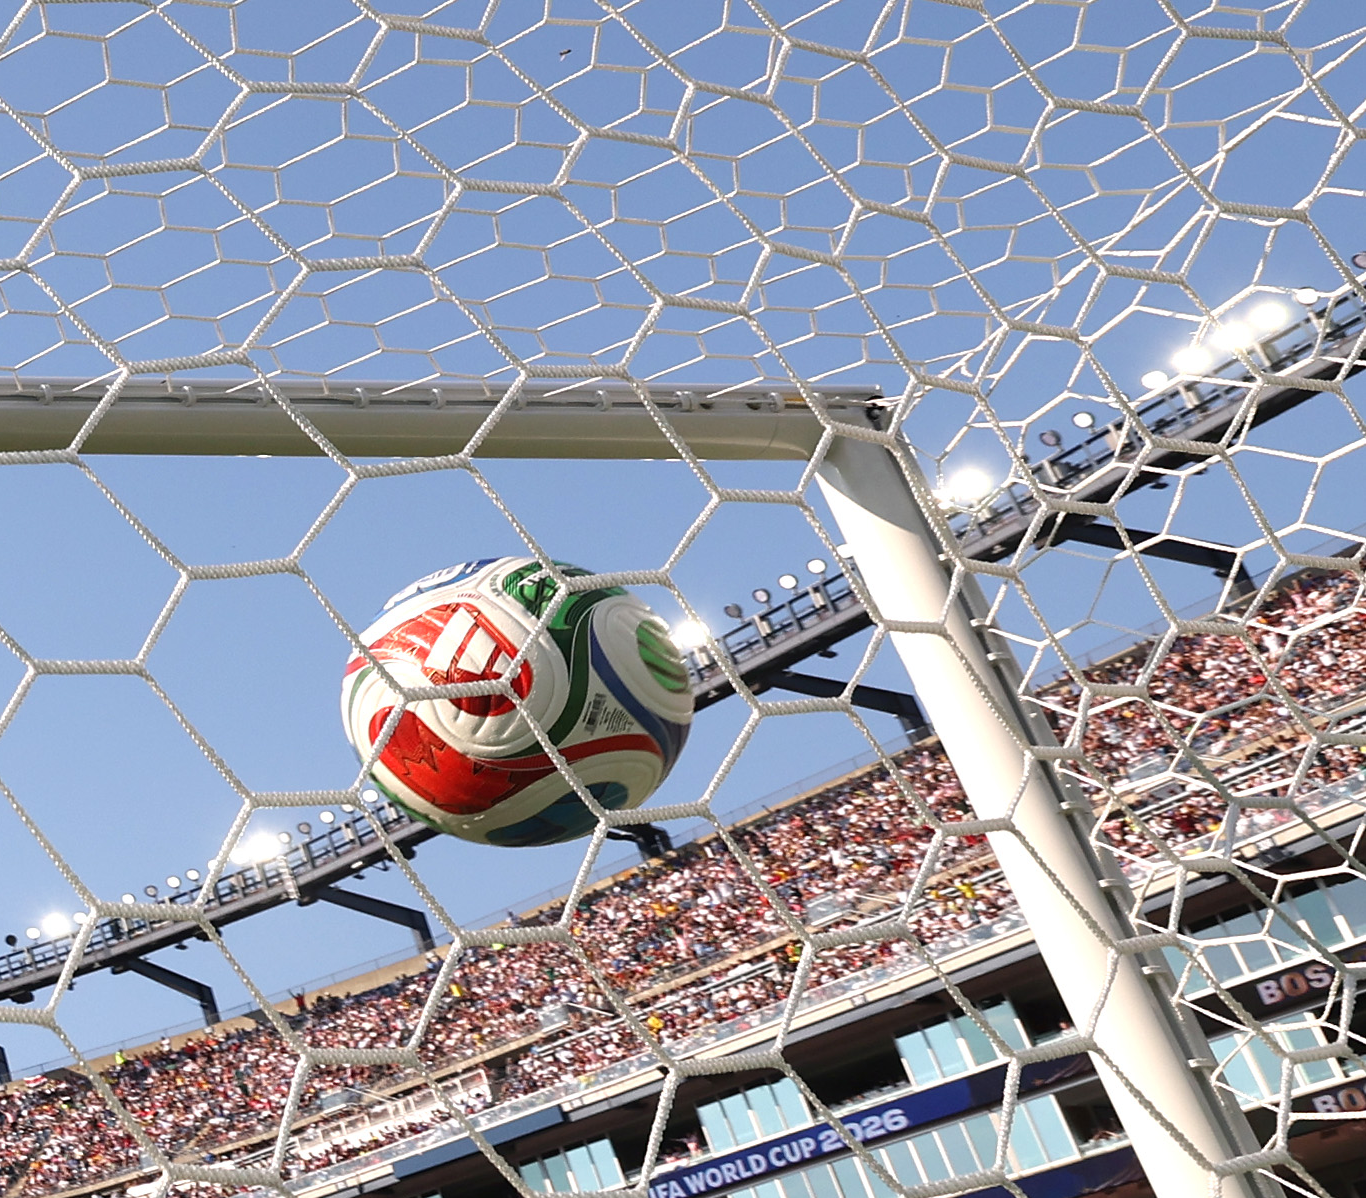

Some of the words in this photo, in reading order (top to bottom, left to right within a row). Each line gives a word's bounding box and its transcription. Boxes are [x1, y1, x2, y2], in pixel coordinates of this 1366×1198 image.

[1256, 963, 1333, 1006] BOS
[684, 1155, 768, 1195] WORLD
[767, 1137, 818, 1168] CUP
[818, 1108, 910, 1153] 2026
